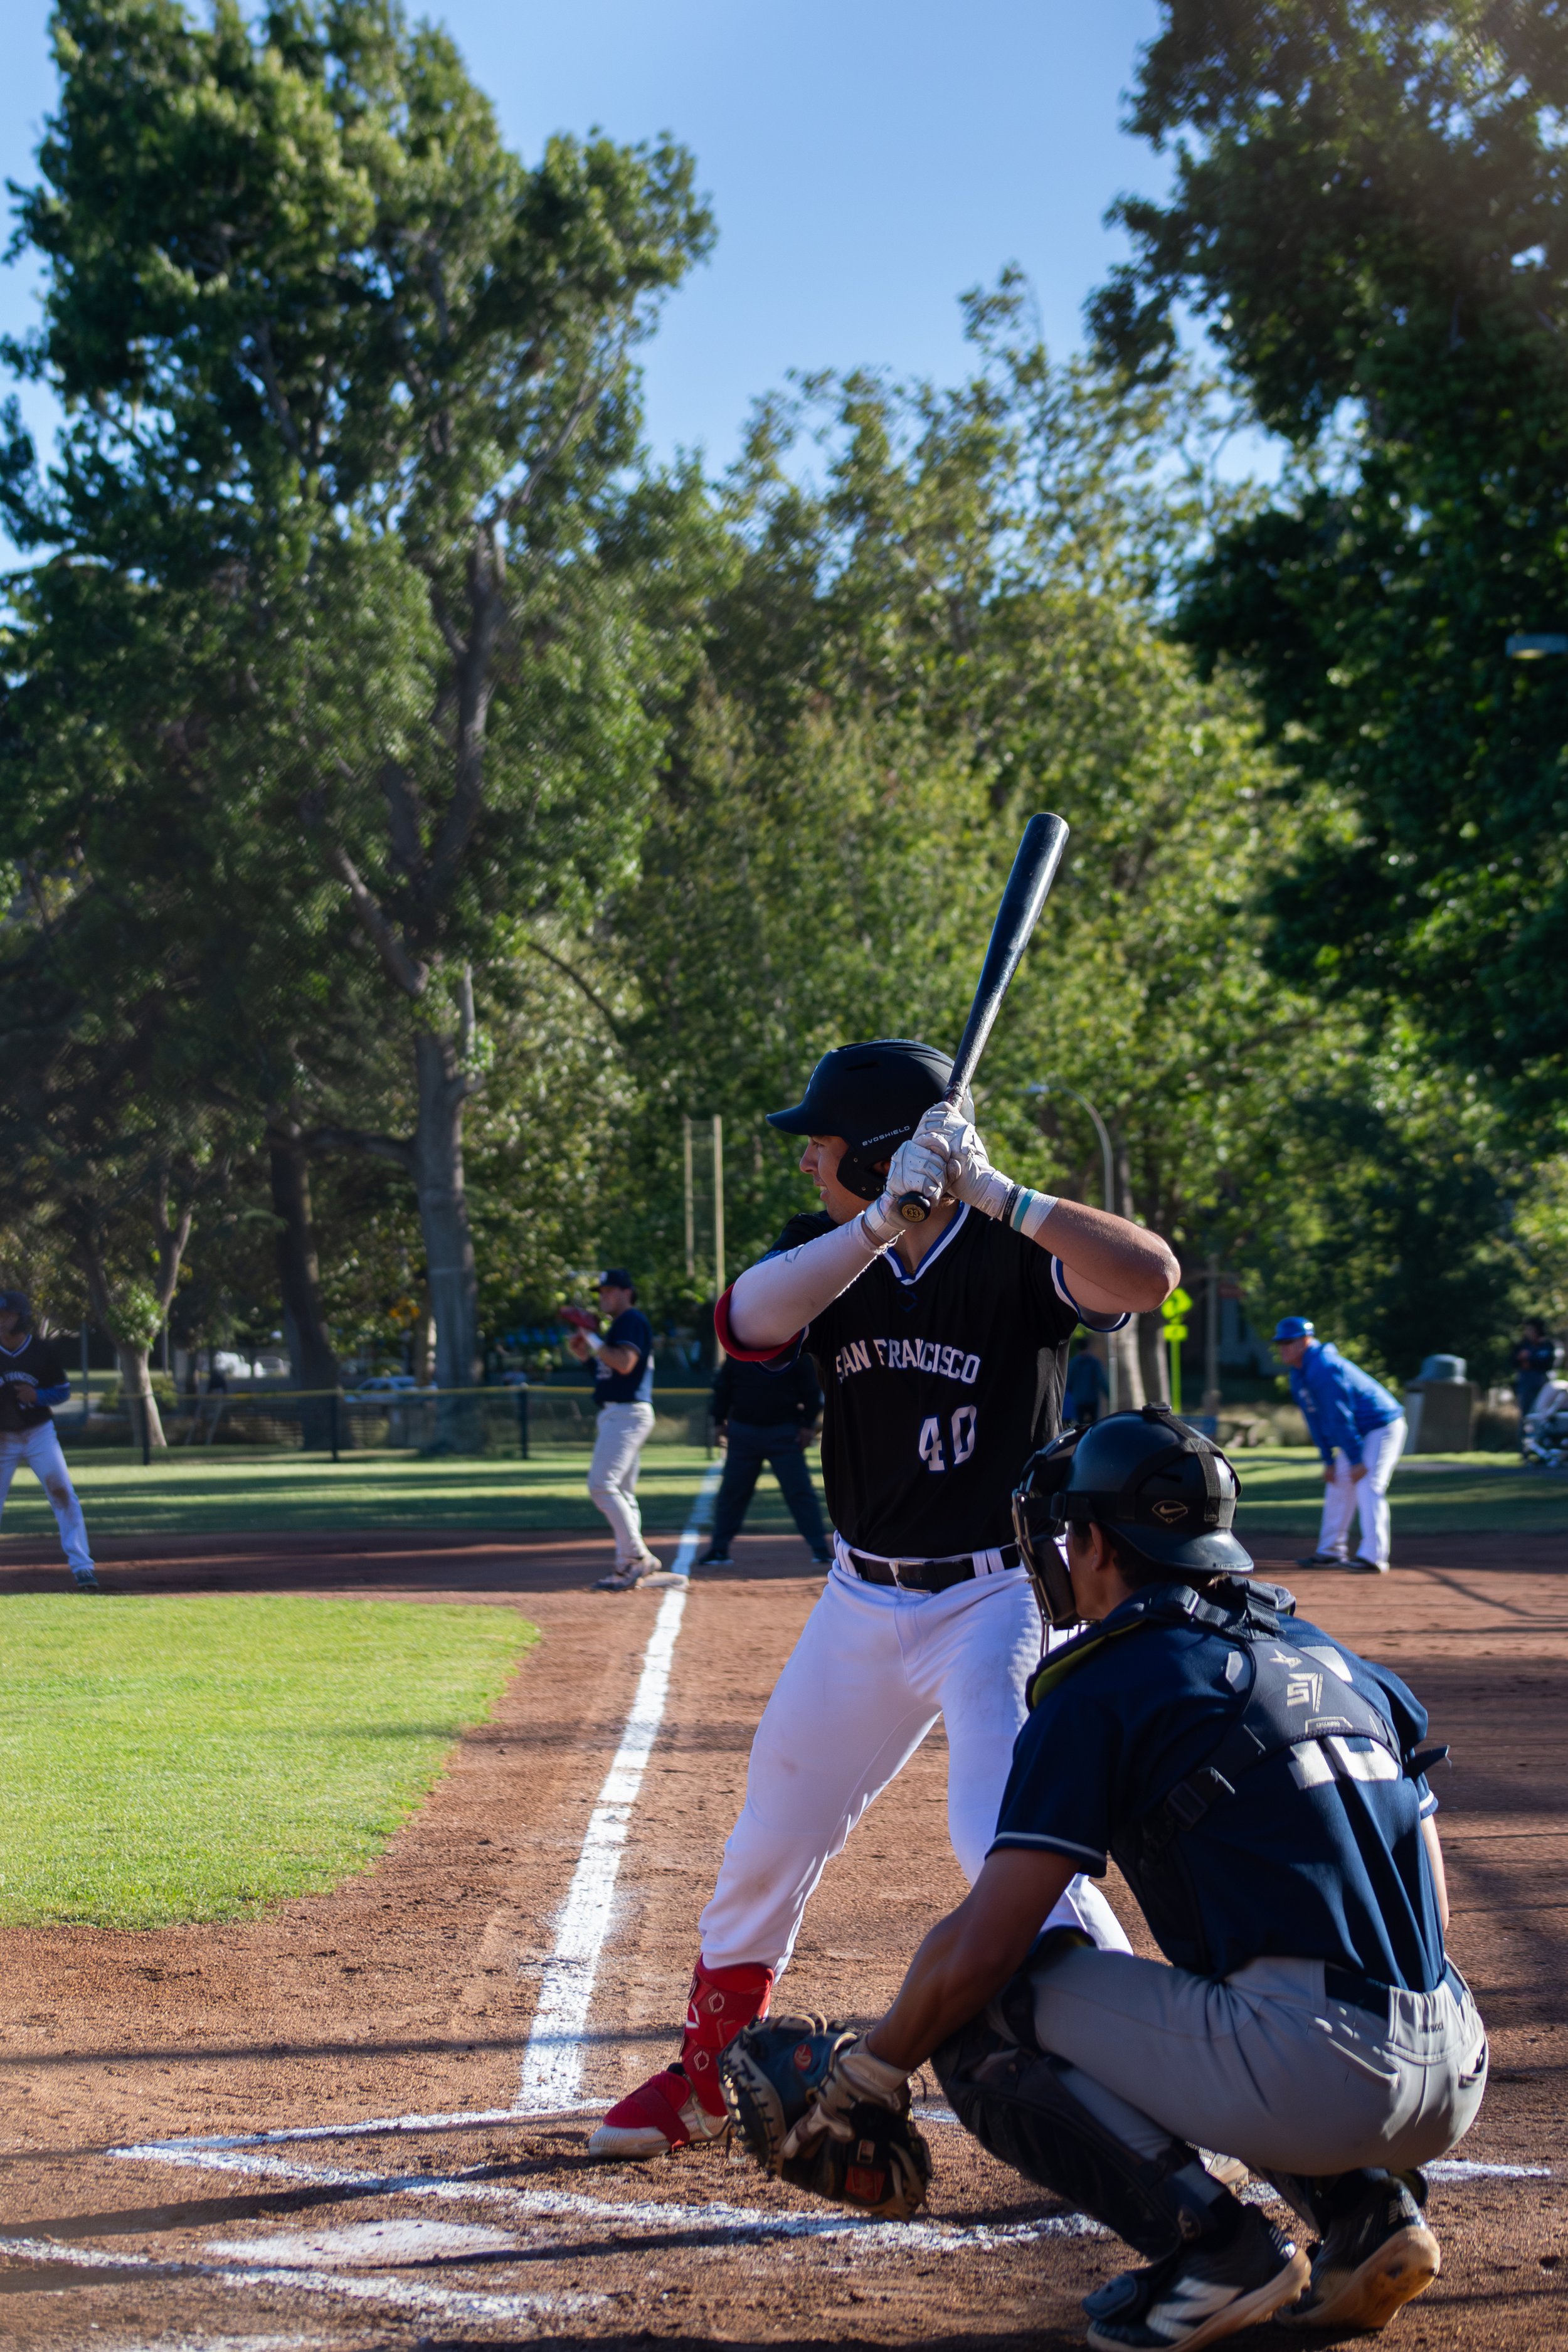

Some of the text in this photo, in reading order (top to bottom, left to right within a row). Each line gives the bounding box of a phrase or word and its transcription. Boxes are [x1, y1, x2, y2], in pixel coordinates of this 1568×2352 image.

[835, 1338, 980, 1384] SAN FRANCISCO
[918, 1404, 977, 1471] 40
